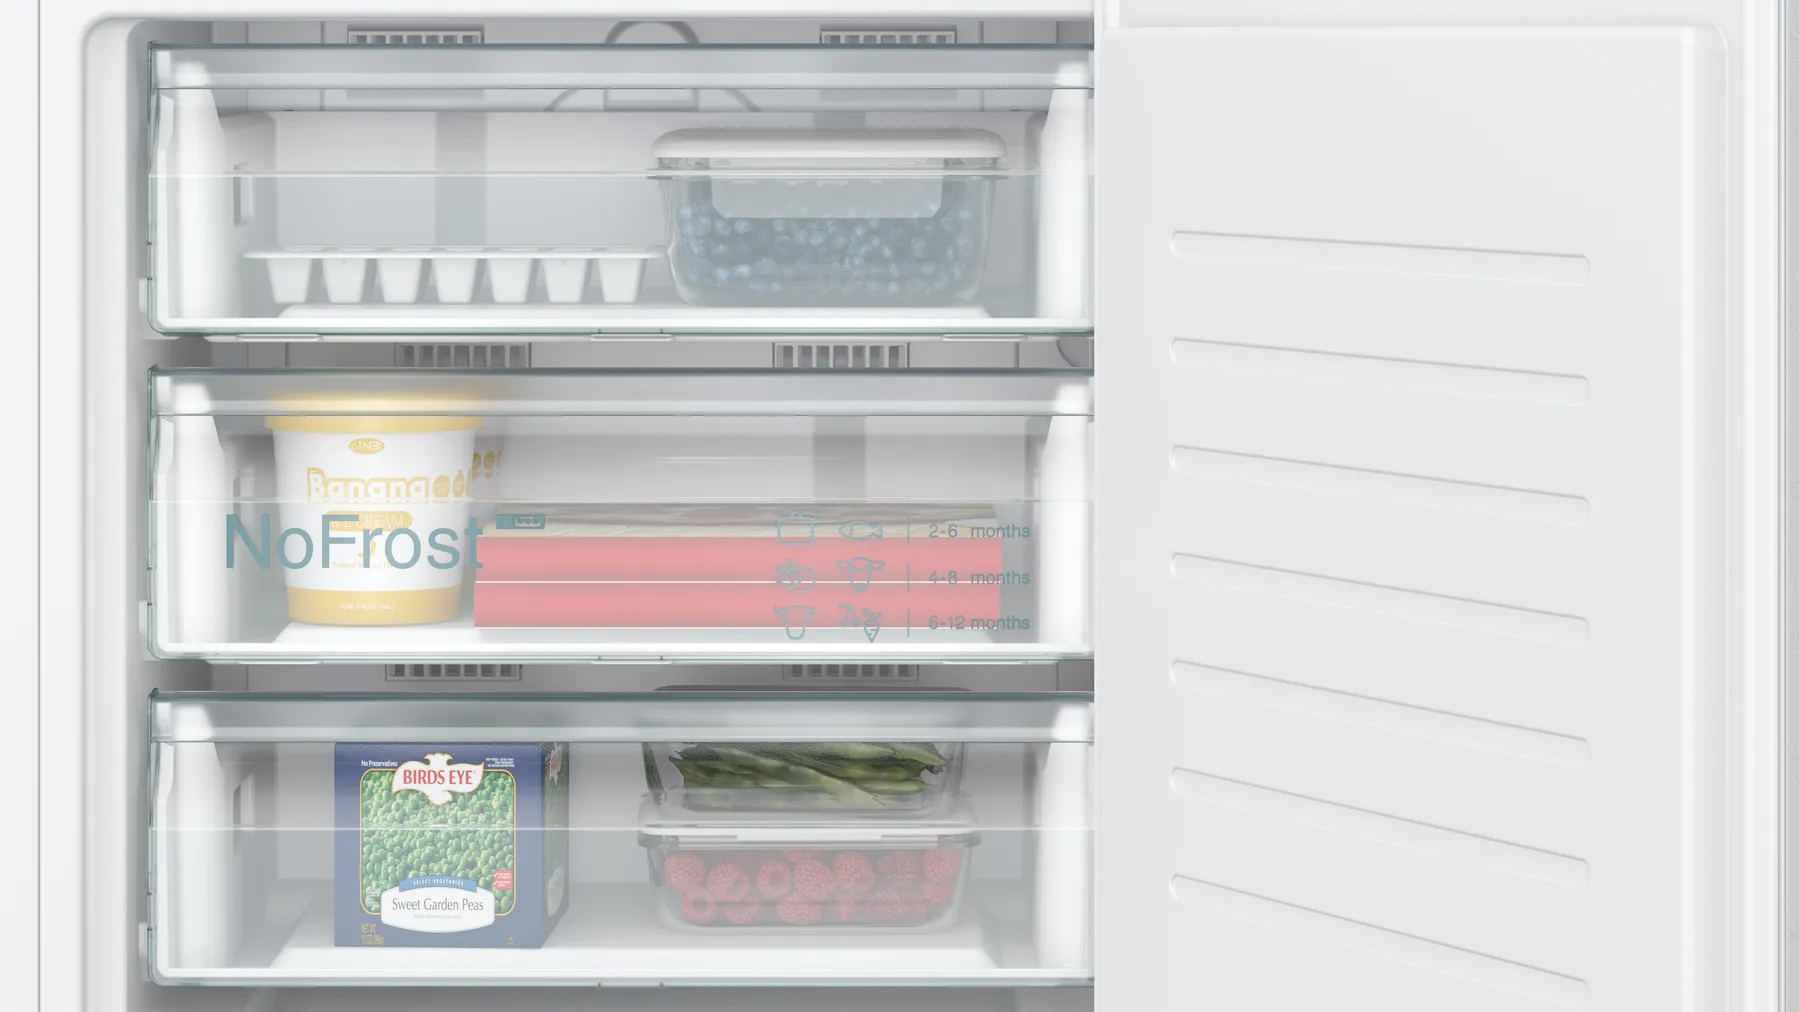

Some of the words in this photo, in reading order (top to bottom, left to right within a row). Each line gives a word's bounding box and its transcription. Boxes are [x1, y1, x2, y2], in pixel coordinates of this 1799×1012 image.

[307, 467, 429, 502] Banana
[355, 514, 405, 529] CREAM
[928, 524, 958, 538] 2-6
[971, 524, 1031, 538] months
[226, 514, 484, 569] NoFrost
[928, 571, 958, 585] 4-8
[971, 571, 1031, 584] months
[928, 616, 965, 630] 6-12
[971, 616, 1031, 629] months
[368, 760, 398, 768] Preservatives
[403, 769, 446, 785] BIRDS
[413, 878, 431, 886] SELECT
[432, 878, 464, 887] VEGETABLES
[392, 897, 421, 911] Sweet
[423, 897, 459, 911] Garden
[462, 898, 484, 911] Peas
